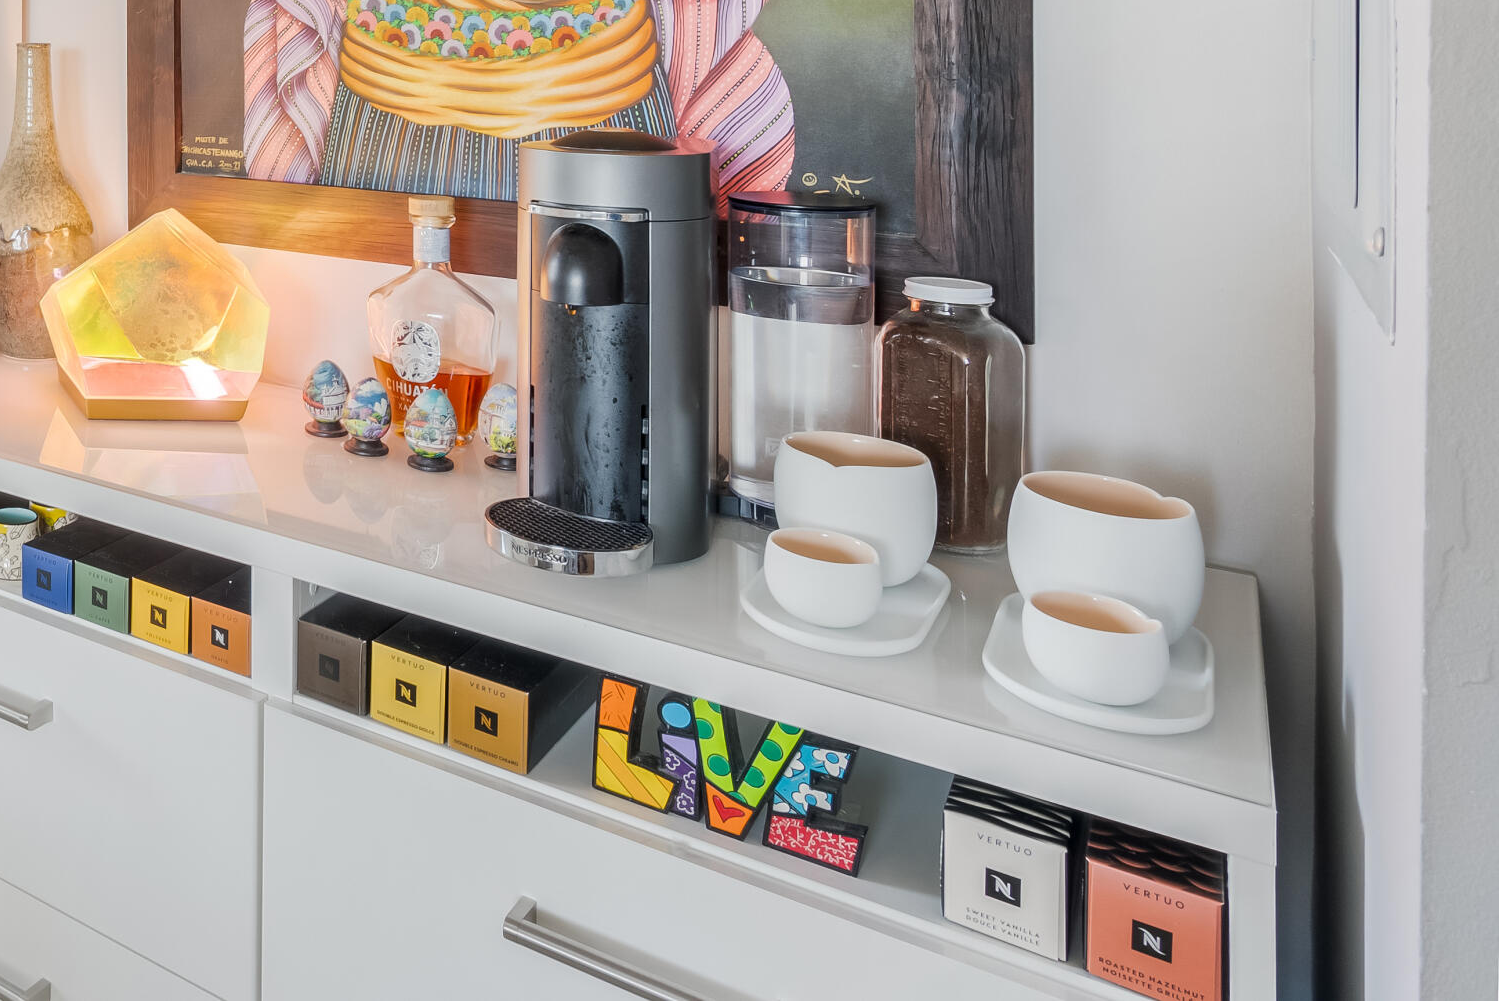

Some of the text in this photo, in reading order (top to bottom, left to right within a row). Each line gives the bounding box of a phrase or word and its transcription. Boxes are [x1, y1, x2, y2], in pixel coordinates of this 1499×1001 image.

[386, 377, 449, 398] CIHUAT
[511, 541, 568, 564] NESPRESSO
[390, 654, 425, 671] VERTUO
[469, 680, 506, 699] VERTUO
[977, 832, 1032, 857] VERTUO
[1123, 882, 1185, 910] VERTUO
[965, 914, 1040, 946] DOUCE VANILLE
[966, 907, 1040, 939] SWEET VANILLA
[1138, 926, 1166, 956] N
[1098, 956, 1205, 1001] ROASTED HAZELNUT
[1102, 966, 1153, 990] NOISETTE
